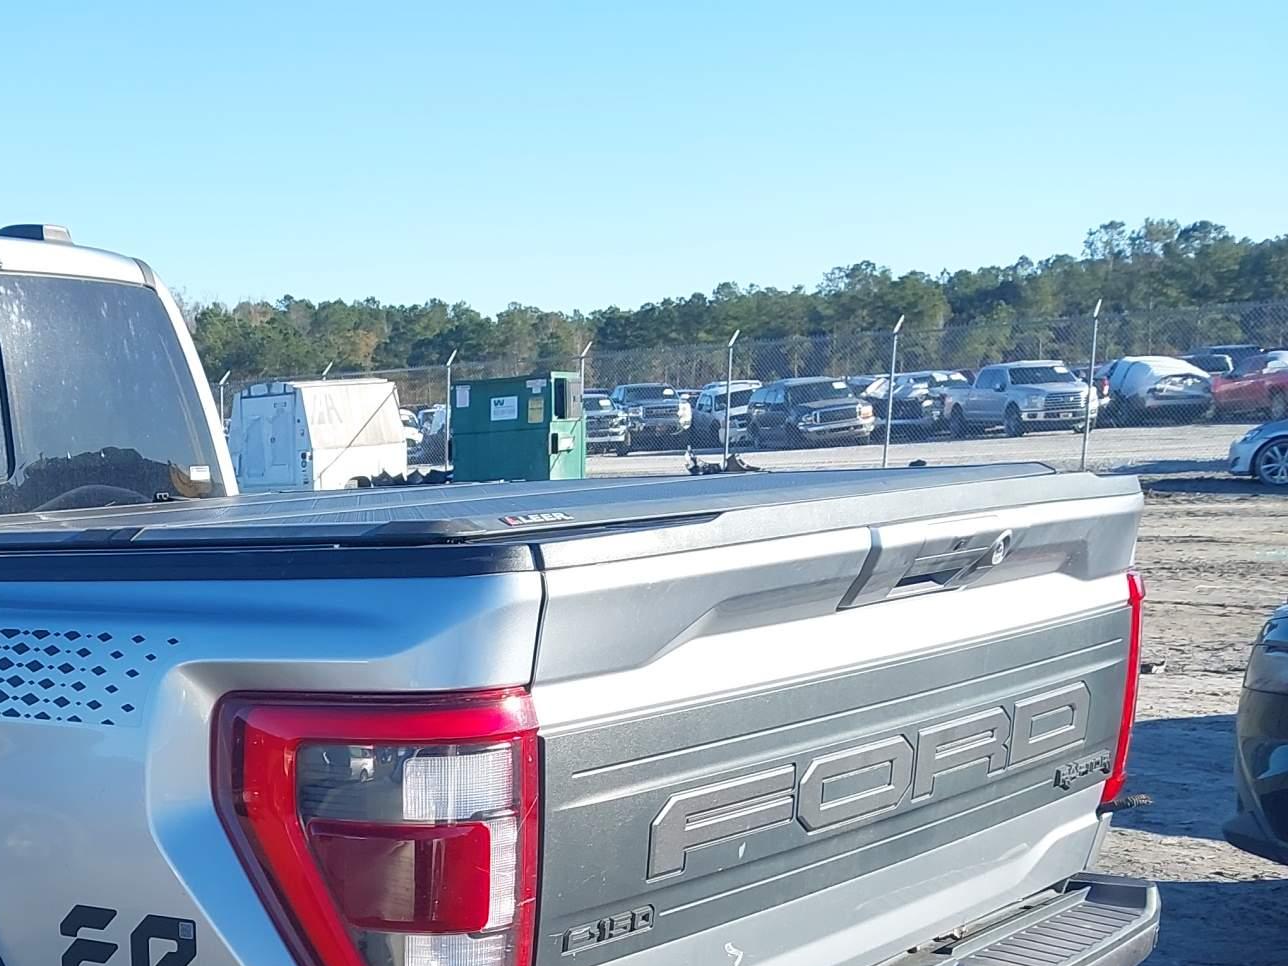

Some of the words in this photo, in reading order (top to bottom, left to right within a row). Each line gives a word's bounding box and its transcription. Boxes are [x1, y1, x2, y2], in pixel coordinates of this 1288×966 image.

[517, 511, 575, 524] LEER
[646, 680, 1092, 883] FORD
[562, 903, 655, 955] F-150
